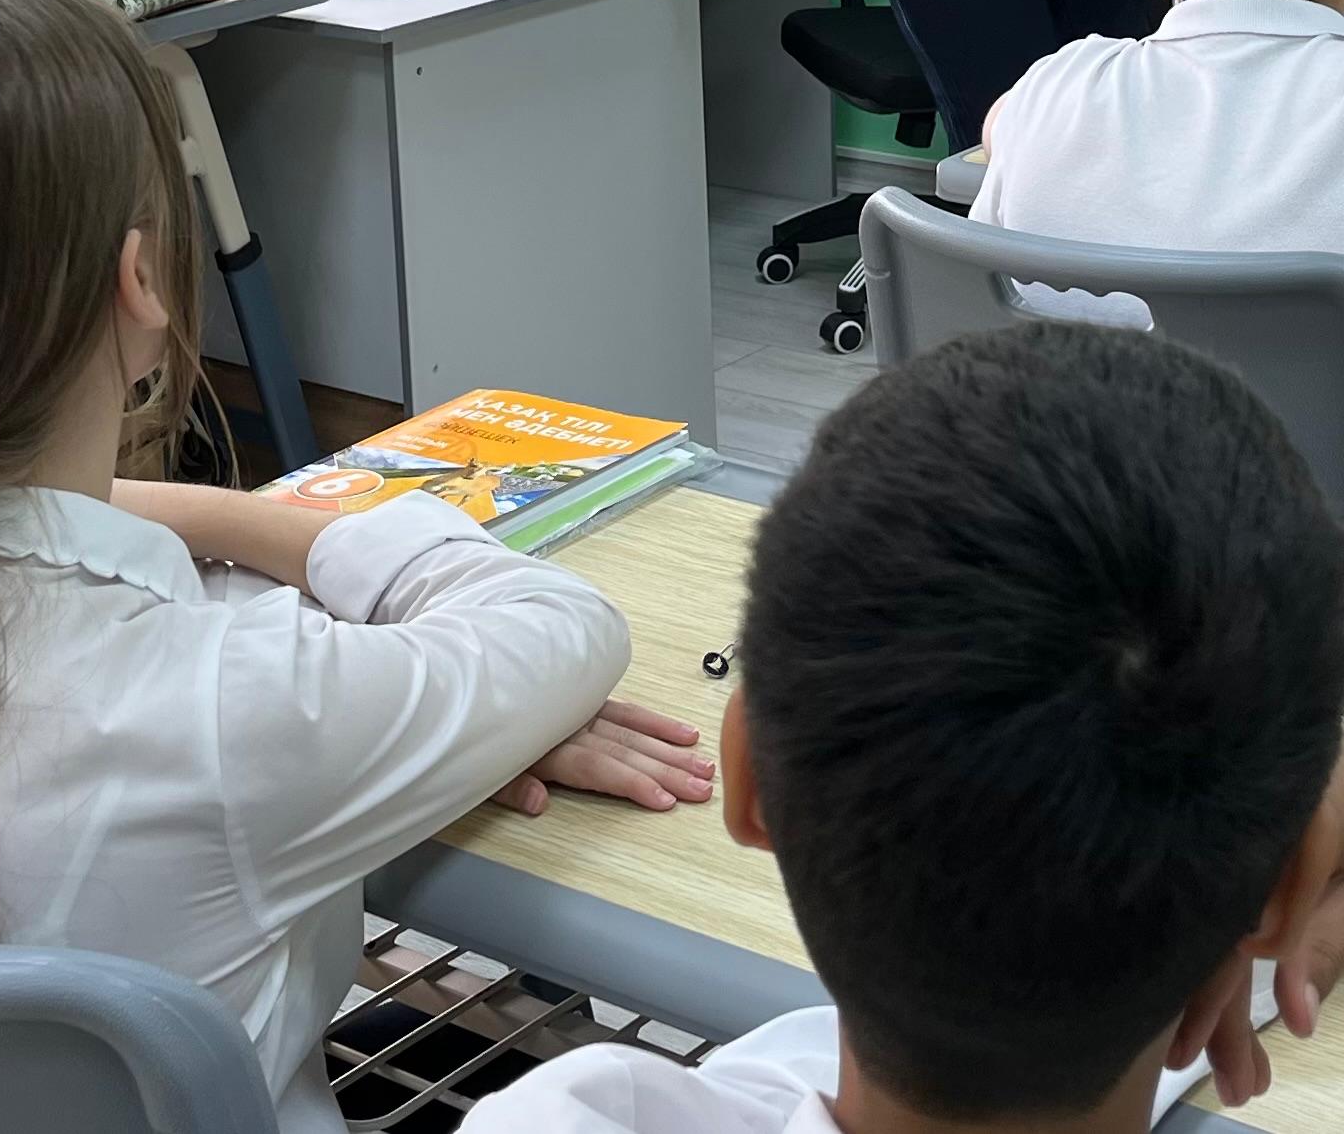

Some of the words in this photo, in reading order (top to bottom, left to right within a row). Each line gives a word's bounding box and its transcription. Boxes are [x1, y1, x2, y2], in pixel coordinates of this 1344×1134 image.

[448, 408, 505, 425] МЕН
[504, 419, 633, 450] ӘДЕБИЕТІ
[560, 416, 613, 434] ТІЛІ
[309, 473, 369, 495] 6
